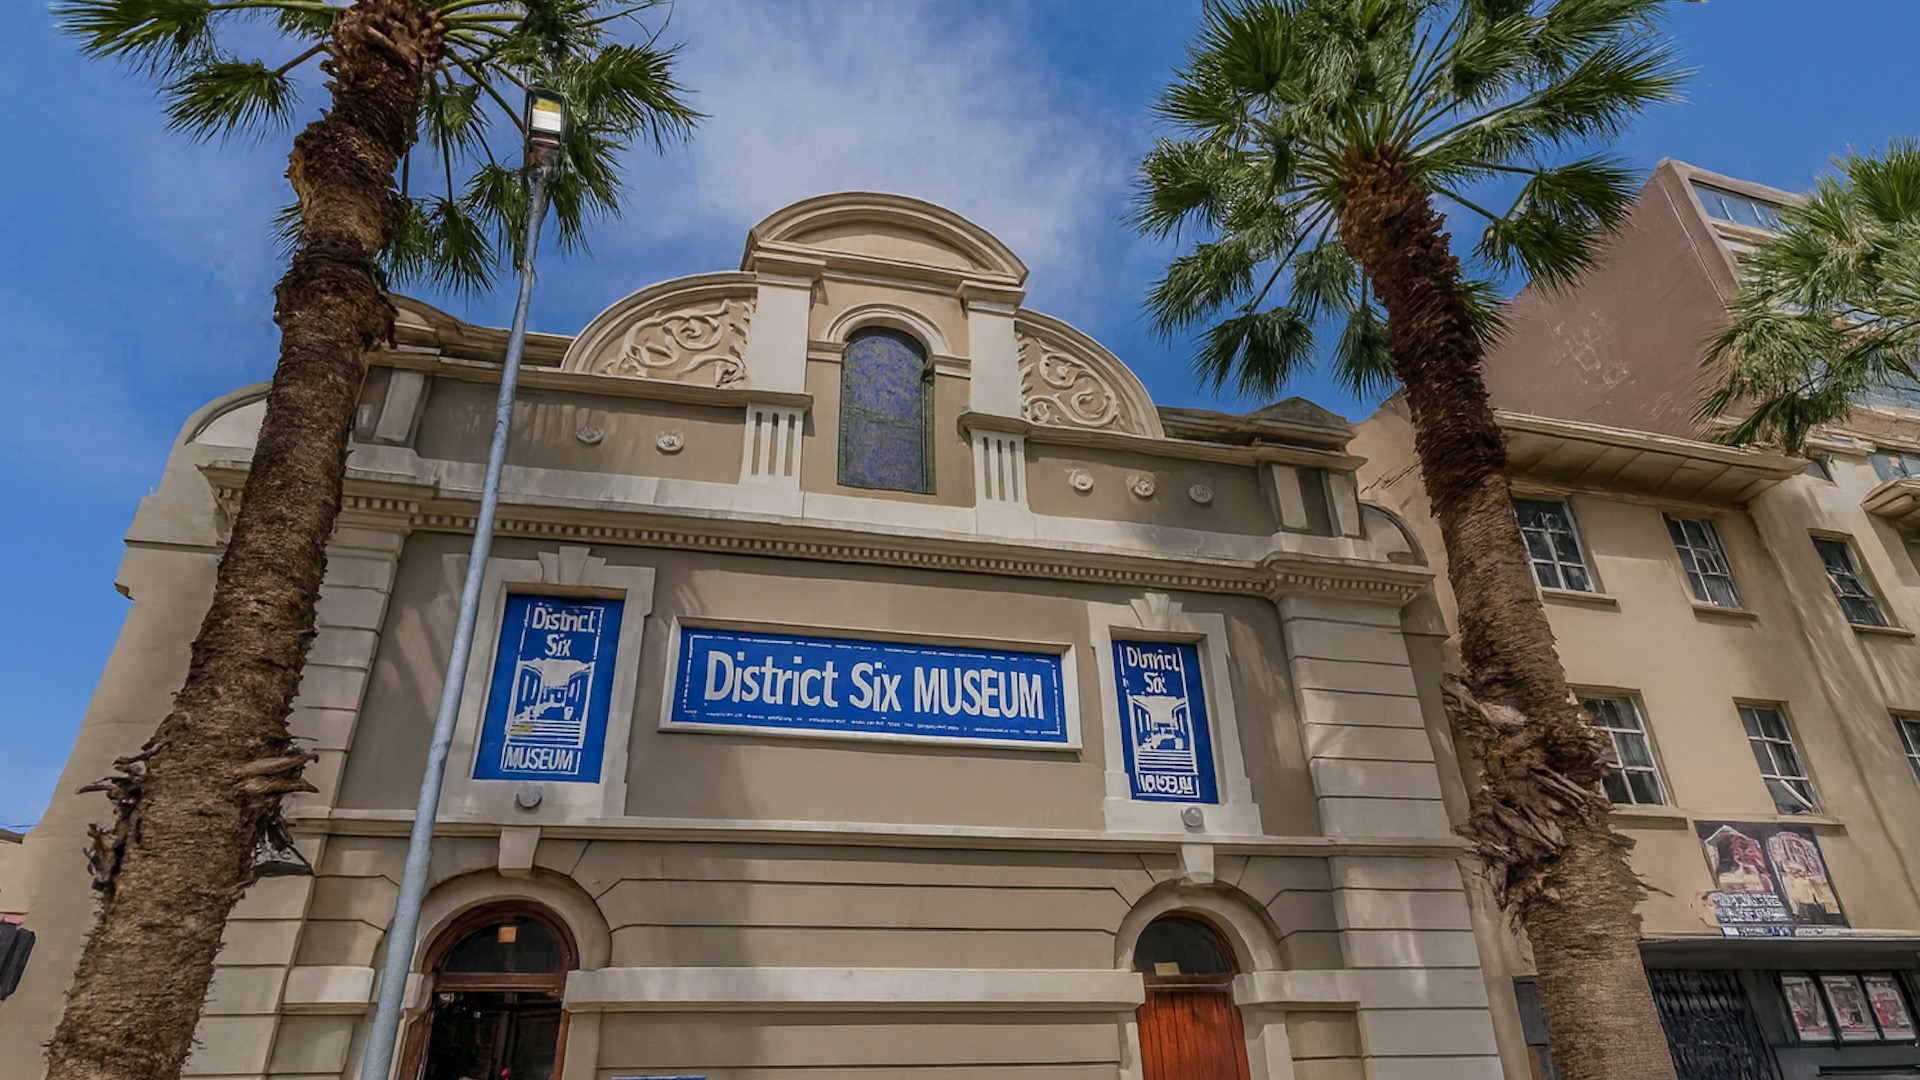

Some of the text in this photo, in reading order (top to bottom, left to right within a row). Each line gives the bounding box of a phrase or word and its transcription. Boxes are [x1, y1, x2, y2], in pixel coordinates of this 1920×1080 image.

[544, 633, 572, 657] Six
[704, 650, 1045, 720] District Six MUSEUM
[504, 747, 573, 771] MUSEUM
